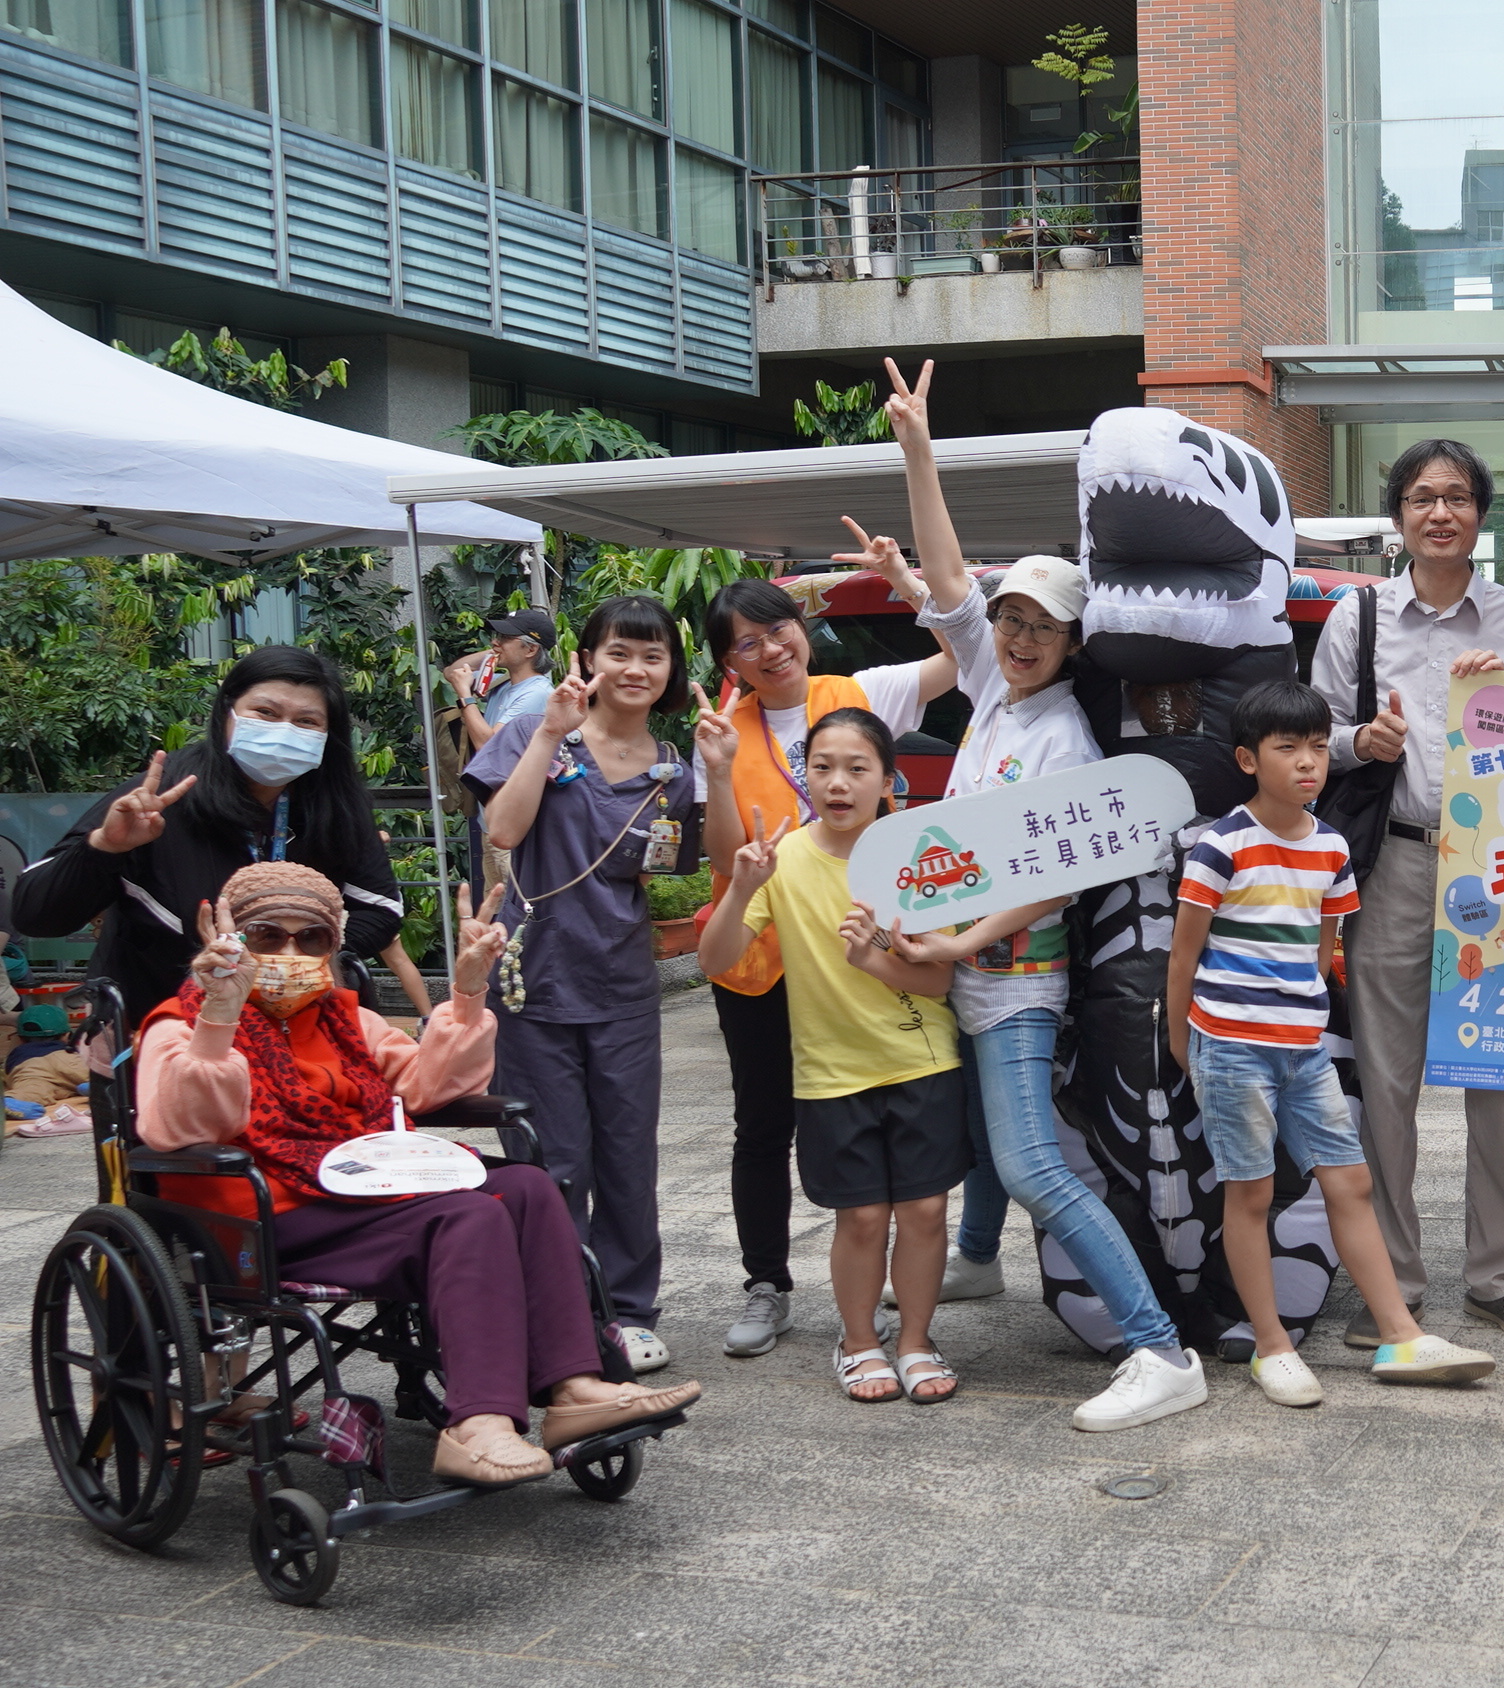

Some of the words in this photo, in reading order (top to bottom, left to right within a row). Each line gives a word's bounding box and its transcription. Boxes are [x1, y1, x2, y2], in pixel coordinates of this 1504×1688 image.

[1022, 787, 1128, 840] 新北市
[1008, 819, 1162, 876] 玩具銀行
[1458, 900, 1487, 913] Switch
[1461, 909, 1489, 922] 體驗區
